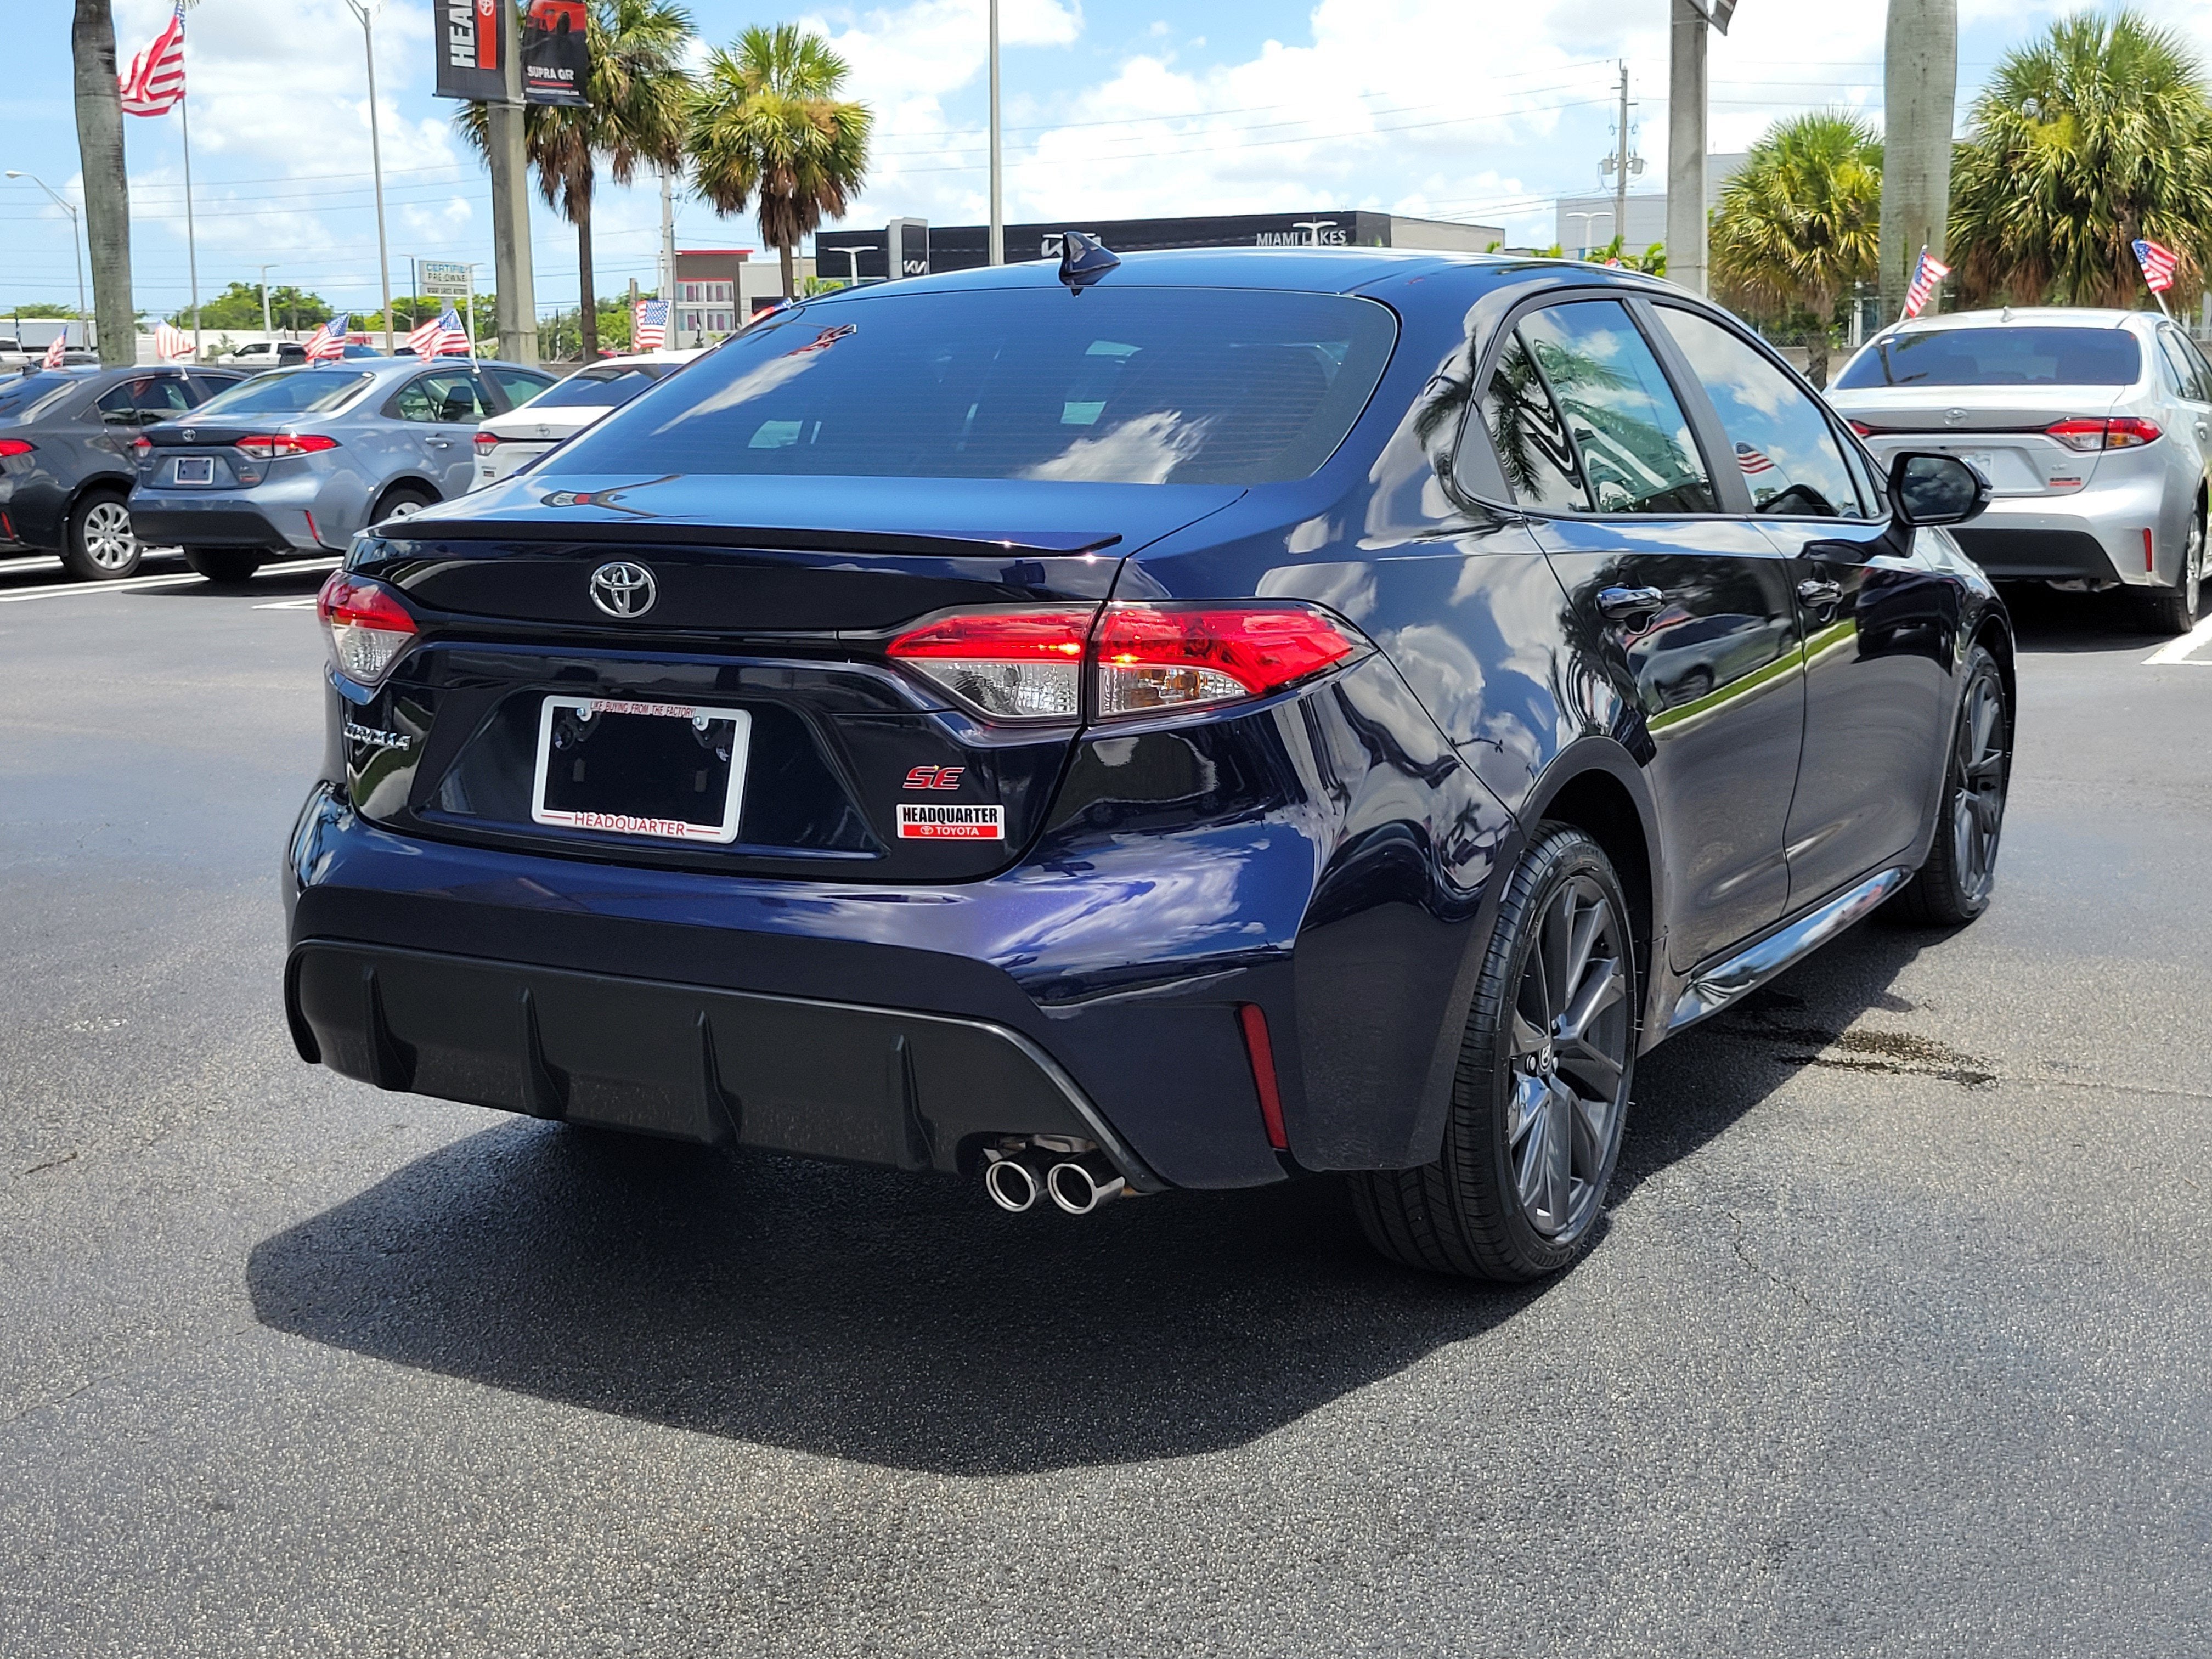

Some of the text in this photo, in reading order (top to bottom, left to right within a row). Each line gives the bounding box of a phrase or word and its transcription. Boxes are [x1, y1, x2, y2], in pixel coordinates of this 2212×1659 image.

[527, 65, 574, 81] SUPRA GR
[1256, 229, 1346, 246] MIAMI LKES
[590, 701, 603, 710] LIKE
[606, 702, 628, 713] BUYING
[631, 703, 649, 714] FROM
[653, 705, 664, 715] THE
[902, 766, 966, 790] SE
[902, 807, 997, 824] HEADQUARTER
[575, 814, 685, 836] HEADQUARTER
[935, 826, 979, 836] TOYOTA
